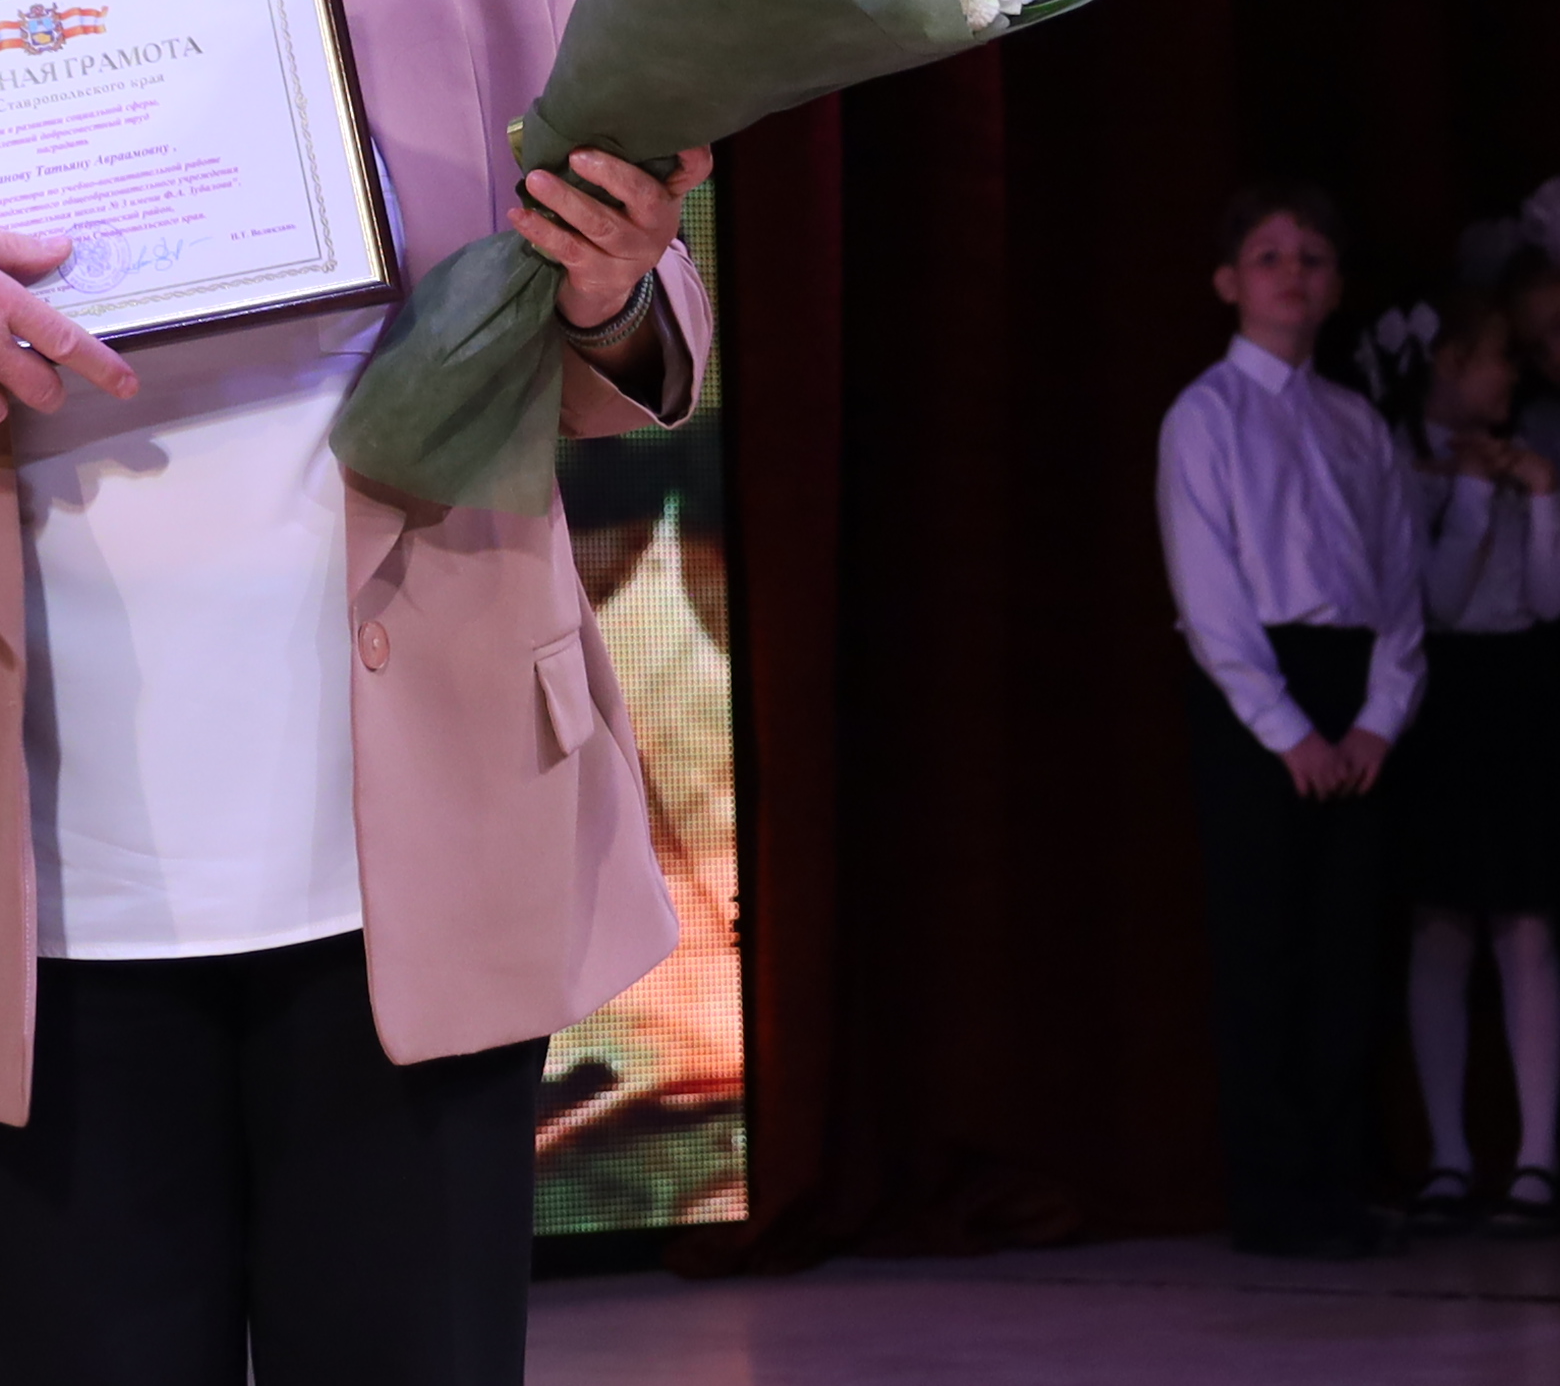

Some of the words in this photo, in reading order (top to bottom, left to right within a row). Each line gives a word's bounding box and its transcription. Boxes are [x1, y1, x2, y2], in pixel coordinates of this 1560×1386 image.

[64, 36, 204, 79] ГРАМОТА
[129, 73, 165, 90] края
[35, 159, 91, 177] Татьяну
